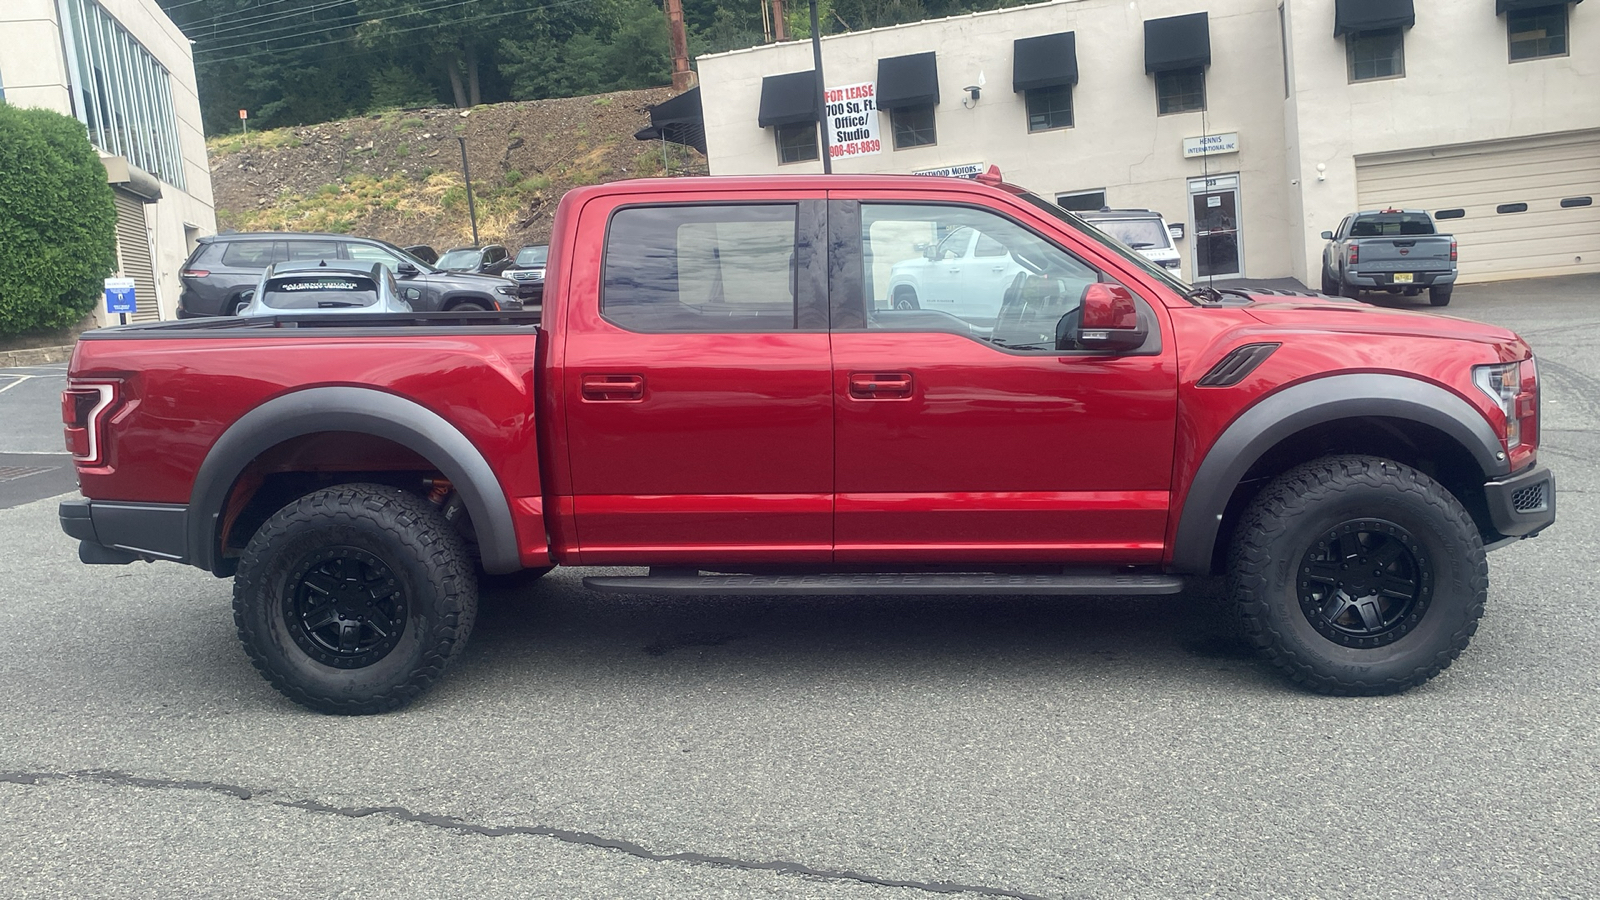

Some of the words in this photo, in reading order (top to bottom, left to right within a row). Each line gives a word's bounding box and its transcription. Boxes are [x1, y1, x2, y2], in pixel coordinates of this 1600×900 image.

[824, 89, 844, 103] FOR
[845, 84, 874, 100] LEASE
[826, 103, 844, 116] 700
[846, 101, 862, 114] Sq.
[864, 99, 876, 111] Ft.
[835, 112, 869, 129] Office/
[837, 128, 870, 142] Studio
[1200, 136, 1222, 145] HENNIS
[829, 139, 881, 157] 908-451-8839
[1187, 144, 1225, 154] INTERNATIONAL
[951, 165, 977, 175] MOTORS
